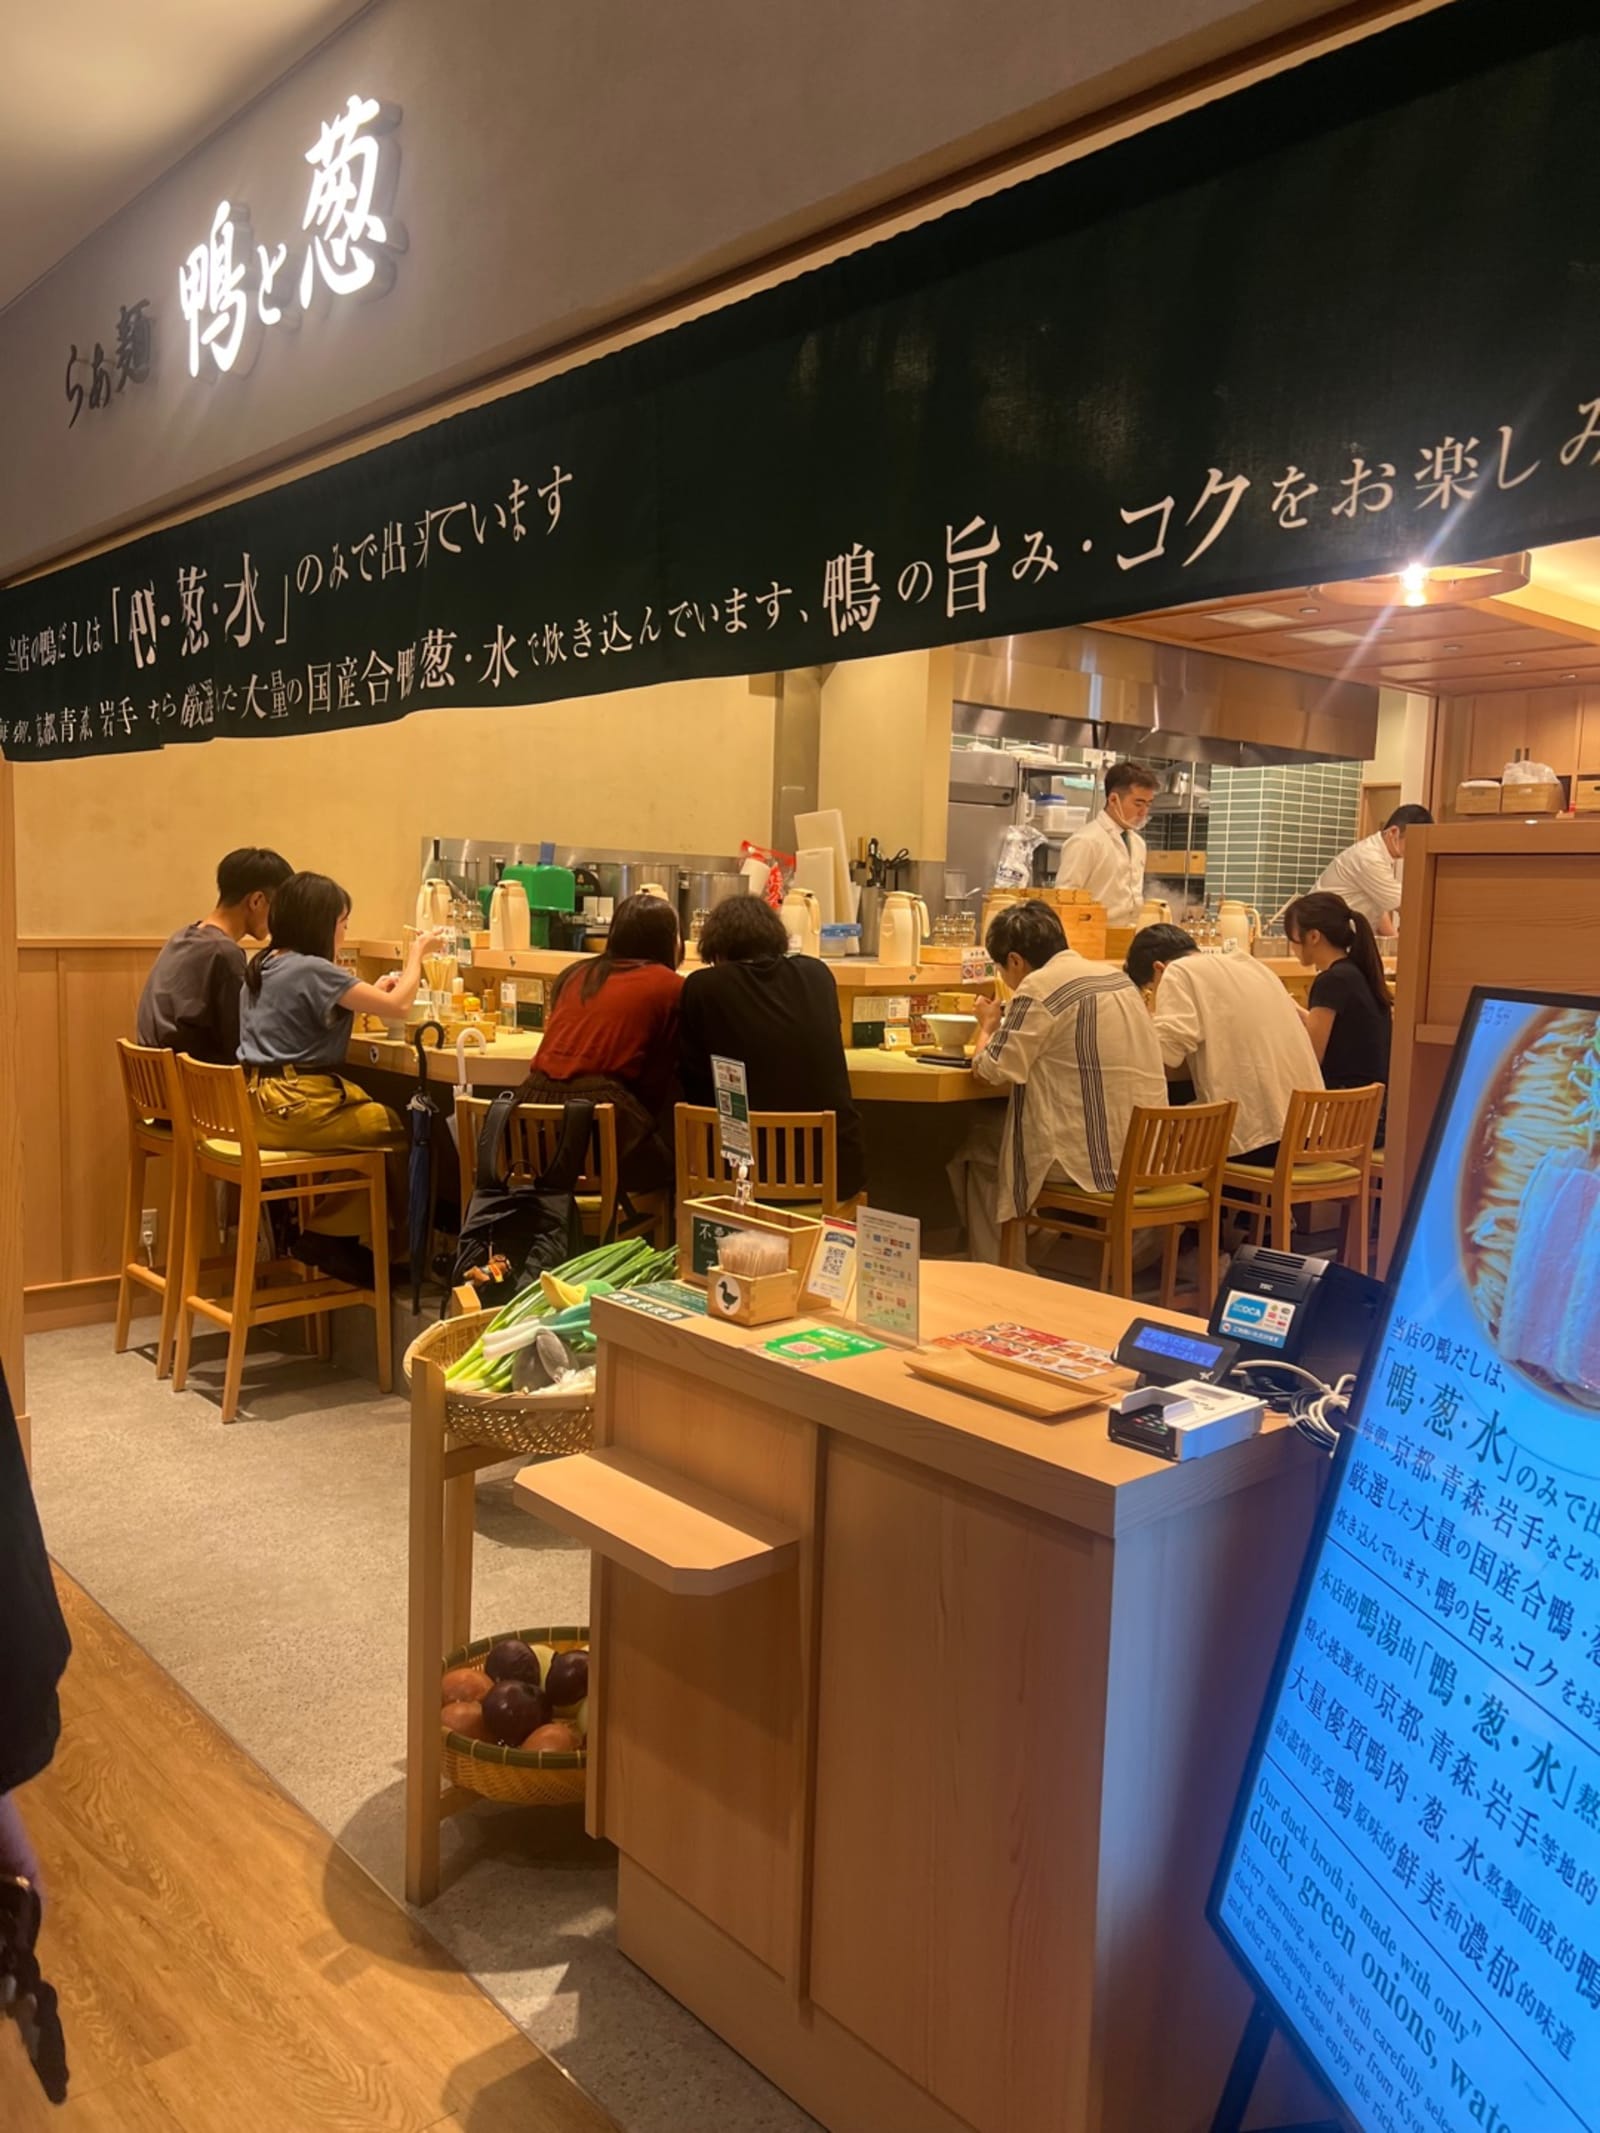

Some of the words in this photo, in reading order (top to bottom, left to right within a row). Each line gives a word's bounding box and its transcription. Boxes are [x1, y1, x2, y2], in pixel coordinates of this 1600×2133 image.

[180, 95, 387, 376] 鴨と葱
[1391, 1315, 1506, 1393] 当店の鴨だしは、
[1240, 1843, 1266, 1888] Every
[1308, 1936, 1323, 1964] we
[1322, 1960, 1347, 1996] cook
[1349, 1991, 1372, 2031] with
[1373, 2027, 1424, 2098] carefully
[1250, 1804, 1294, 1884] duck,
[1298, 1874, 1356, 1959] green
[1360, 1951, 1438, 2070] onions,
[1258, 1776, 1280, 1812] Our
[1281, 1806, 1309, 1850] duck
[1310, 1838, 1344, 1893] broth
[1345, 1881, 1358, 1910] is
[1358, 1904, 1397, 1957] made
[1400, 1952, 1432, 2000] with
[1314, 1983, 1336, 2015] and
[1336, 2010, 1367, 2057] water
[1366, 2052, 1395, 2099] from
[1325, 2035, 1351, 2077] enjoy
[1353, 2072, 1372, 2104] the
